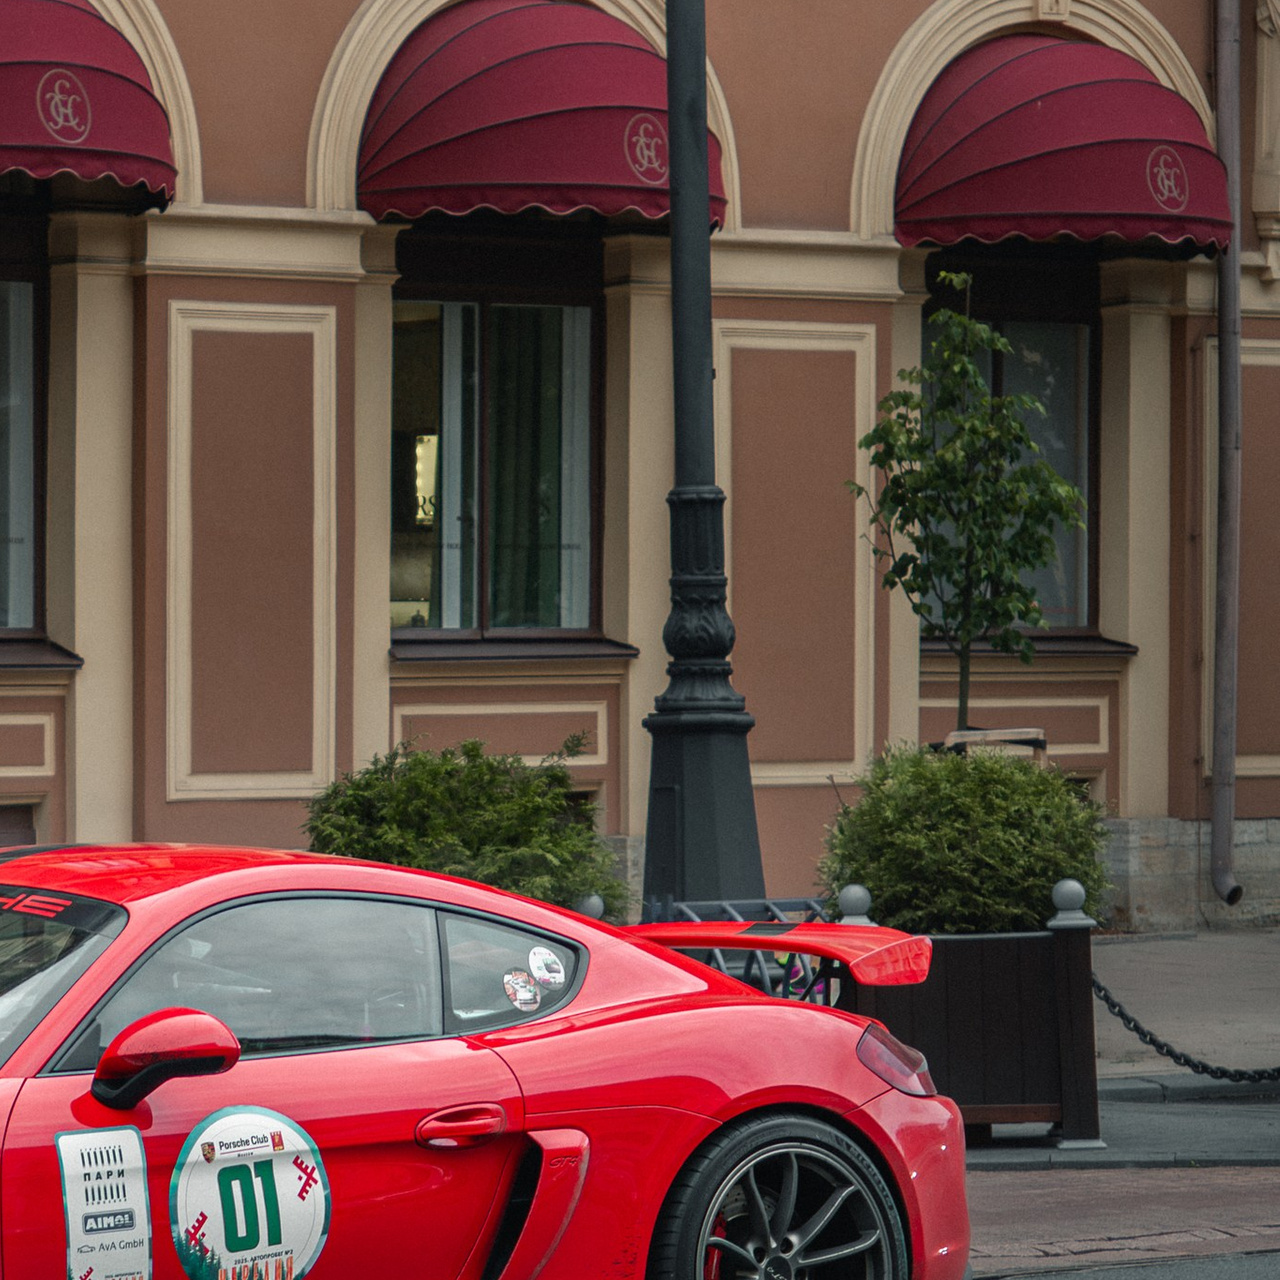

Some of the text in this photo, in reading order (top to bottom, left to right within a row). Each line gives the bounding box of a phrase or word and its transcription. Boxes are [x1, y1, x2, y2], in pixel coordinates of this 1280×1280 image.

[219, 1134, 269, 1150] Porsche Club
[549, 1155, 579, 1168] GT4
[83, 1169, 125, 1182] ПАРИ
[217, 1158, 282, 1253] 01
[85, 1213, 132, 1231] AIMOL
[98, 1238, 144, 1252] AvA GmbH
